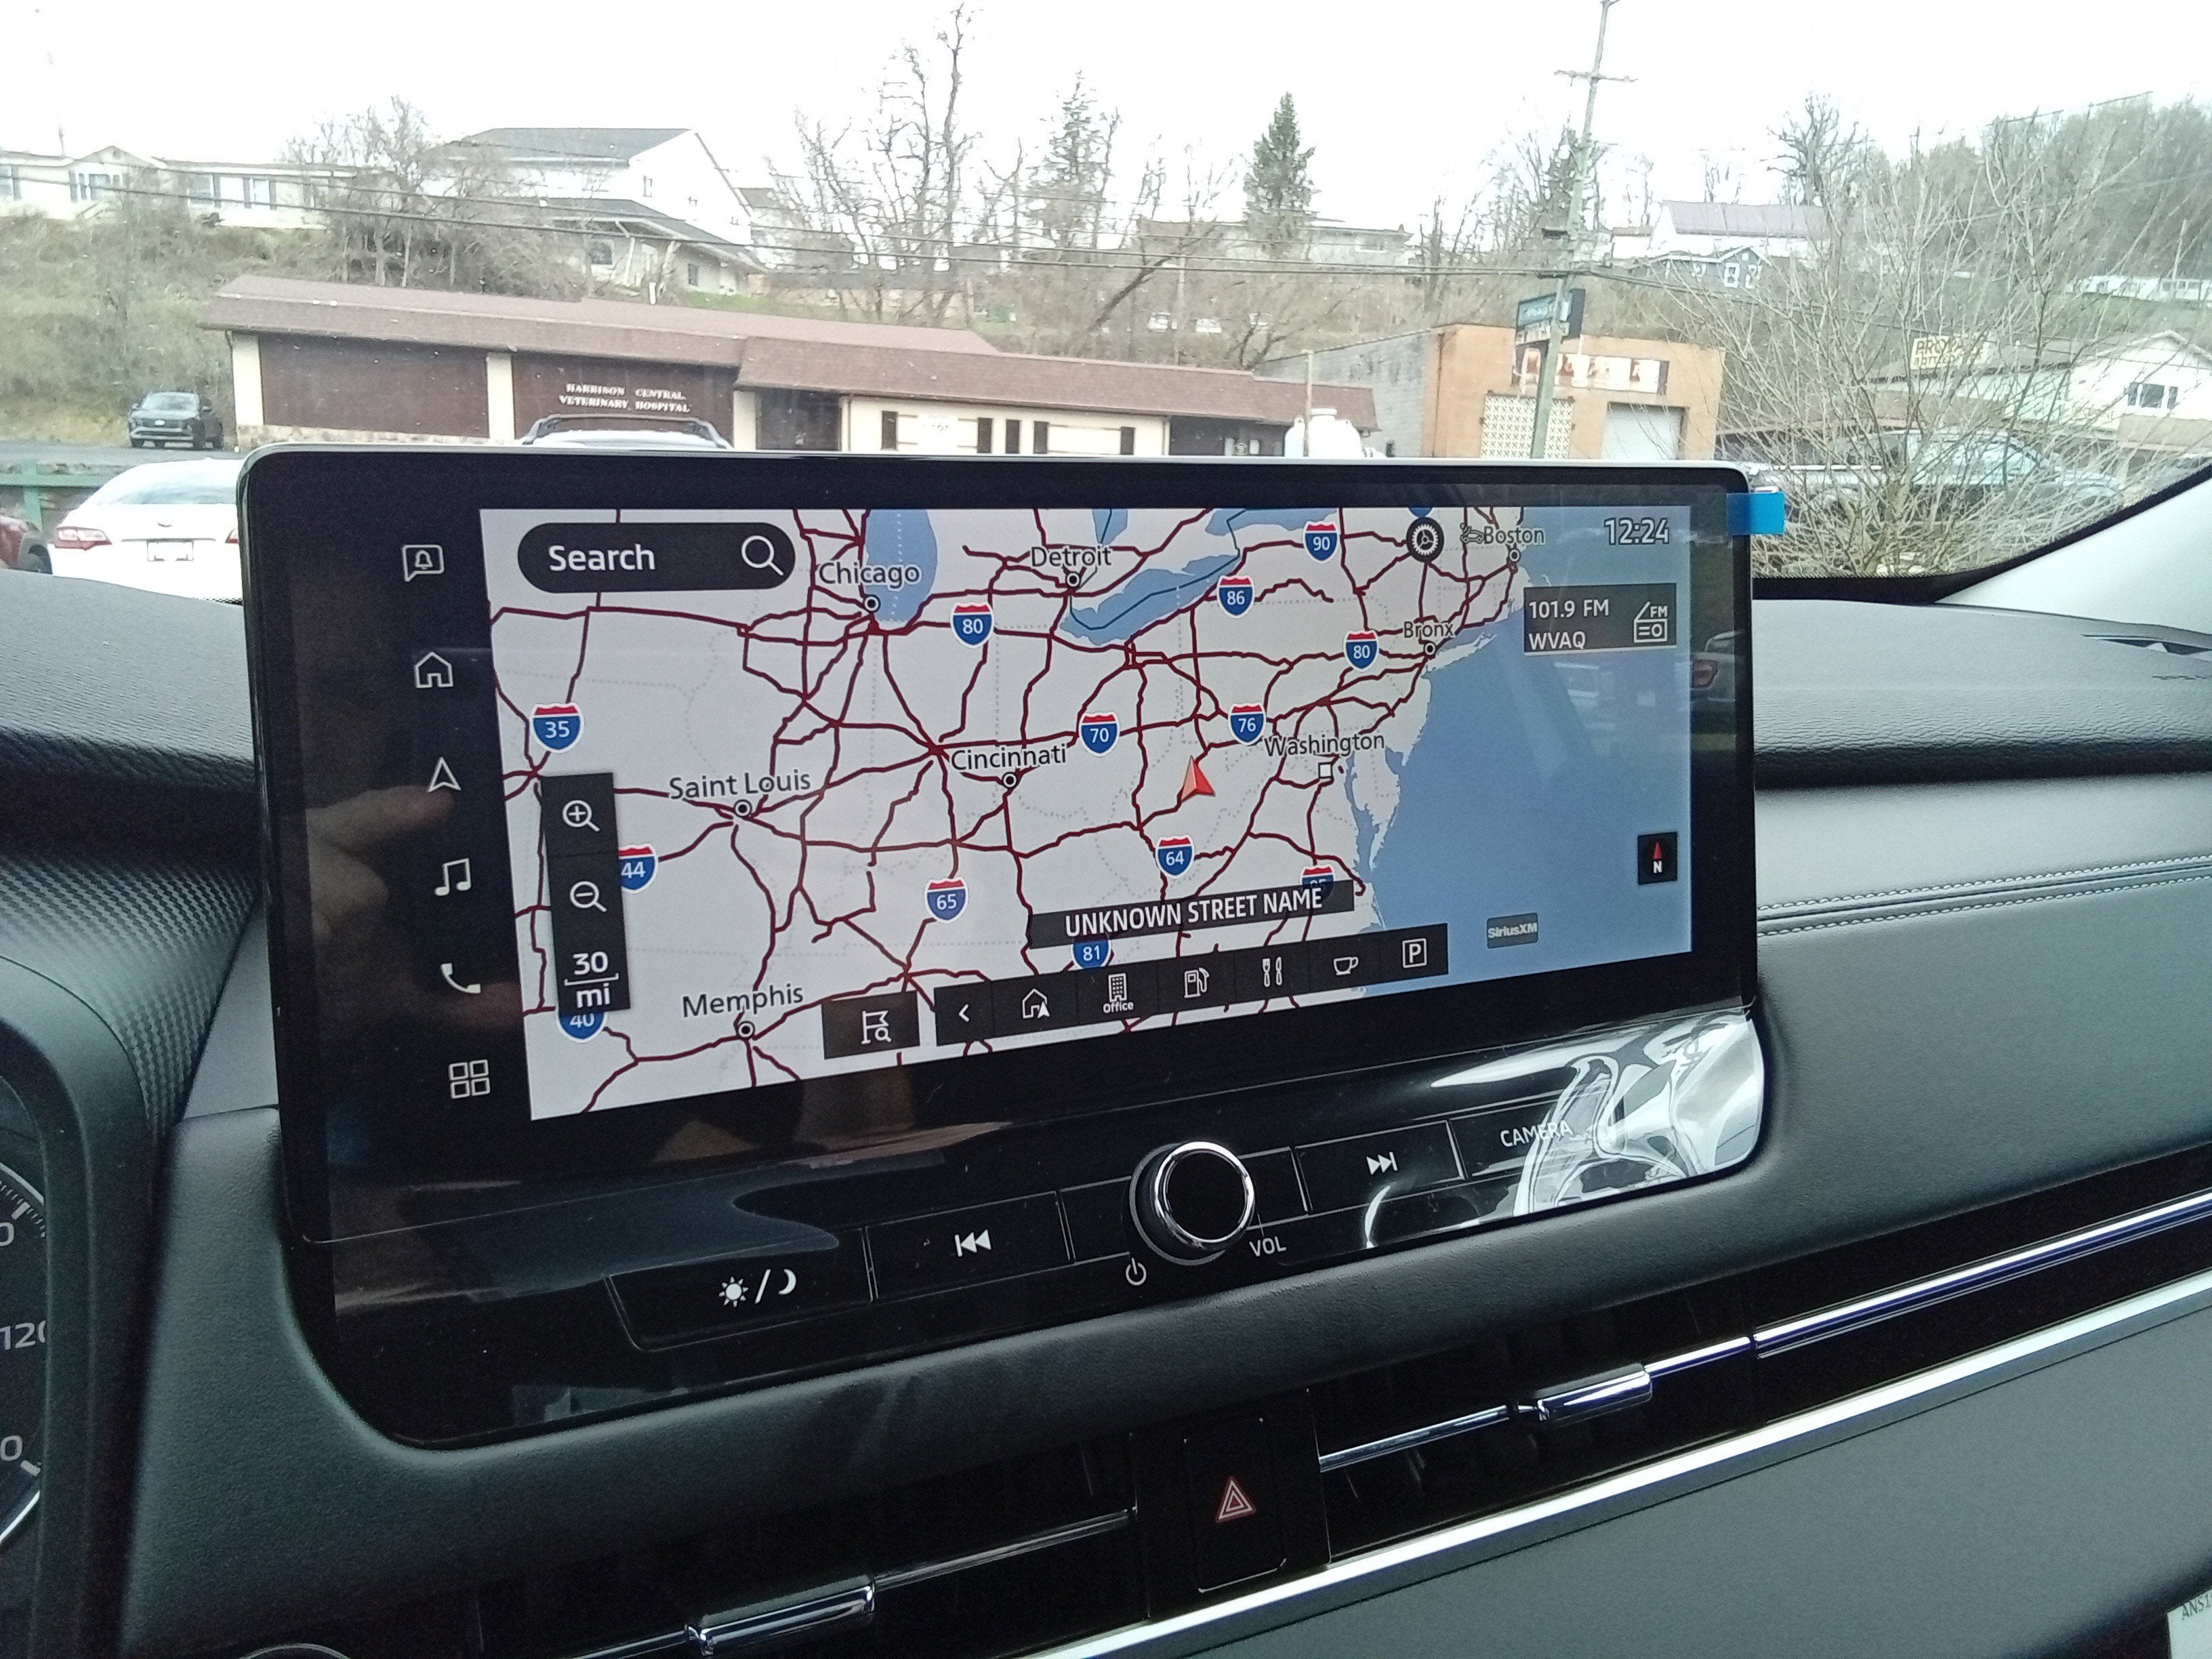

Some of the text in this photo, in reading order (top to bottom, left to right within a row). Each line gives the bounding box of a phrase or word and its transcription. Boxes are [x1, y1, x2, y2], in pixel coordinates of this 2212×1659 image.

[566, 383, 687, 401] HARRISON CENTRAL
[559, 394, 691, 413] VETERINARY HOSPITAL
[1484, 525, 1544, 544] Boston
[1604, 517, 1670, 546] 12:24
[1313, 535, 1330, 552] 90
[548, 543, 656, 572] Search
[1031, 546, 1112, 568] Detroit
[819, 562, 921, 590] Chicago
[1227, 590, 1246, 606] 86
[1529, 599, 1610, 620] 101.9 FM
[1650, 606, 1668, 619] FM
[962, 618, 983, 635] 80
[1404, 621, 1454, 639] Bronx
[1529, 631, 1586, 651] WVAQ
[1353, 644, 1371, 661] 80
[545, 720, 571, 739] 35
[1237, 716, 1256, 733] 76
[1090, 727, 1109, 744] 70
[1265, 732, 1385, 758] Washington
[951, 743, 1067, 771] Cincinnati
[670, 769, 812, 800] Saint Louis
[1166, 851, 1185, 867] 64
[1654, 861, 1662, 874] N
[621, 861, 647, 880] 44
[936, 893, 958, 910] 65
[1065, 887, 1323, 937] UNKNOWN STREET NAME
[1488, 922, 1538, 939] SiriusXM
[574, 951, 609, 975] 30
[1082, 945, 1101, 962] 81
[1409, 943, 1422, 964] P
[576, 983, 611, 1008] mi
[682, 985, 804, 1018] Memphis
[1103, 1002, 1134, 1014] Office
[569, 1013, 595, 1029] 40
[1500, 1120, 1574, 1147] CAMERA
[1249, 1237, 1287, 1258] VOL
